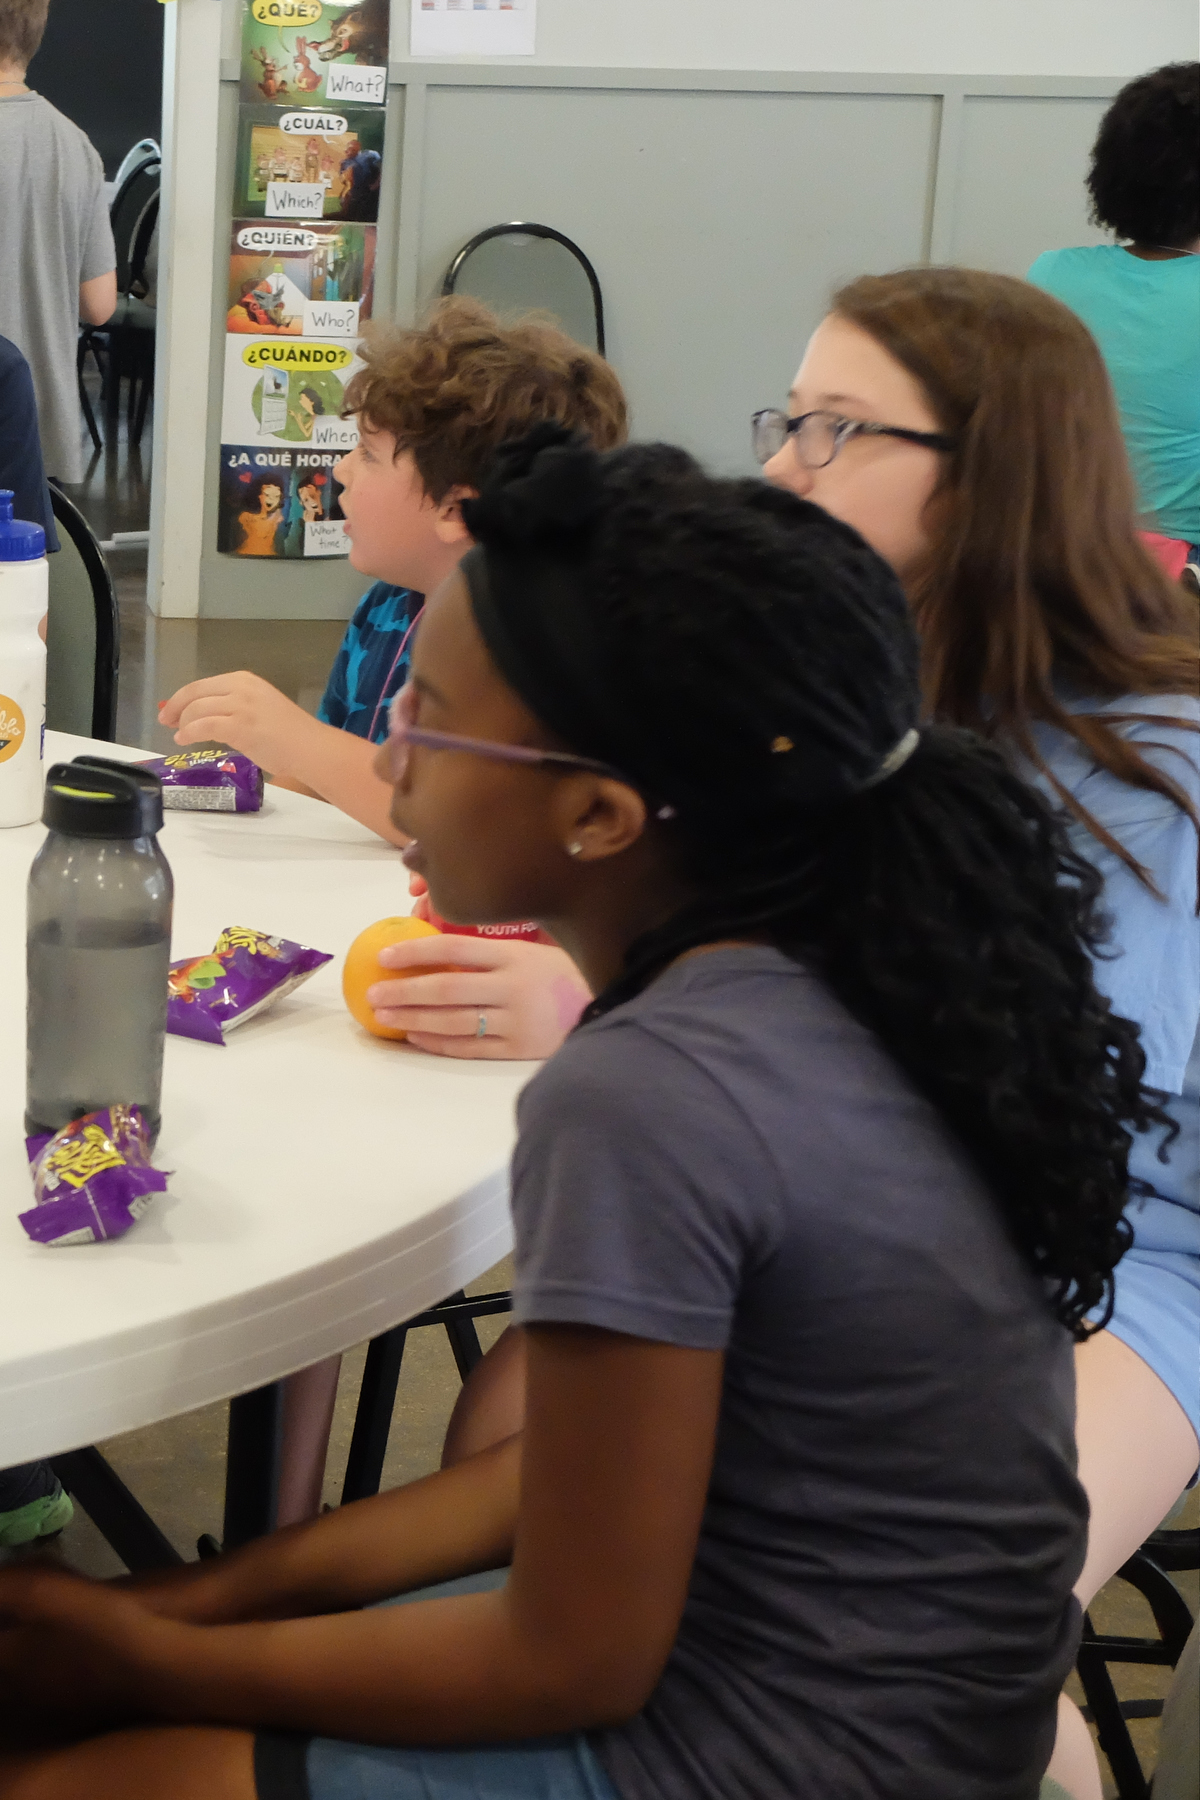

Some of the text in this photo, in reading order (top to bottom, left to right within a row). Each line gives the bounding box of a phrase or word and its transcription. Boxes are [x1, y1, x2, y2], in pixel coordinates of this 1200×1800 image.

[257, 1, 319, 19] ¿QUÉ?
[330, 74, 385, 98] What?
[284, 116, 344, 131] ¿CUÁL?
[272, 189, 322, 211] Which?
[311, 309, 355, 332] Who?
[246, 345, 347, 364] ¿CUÁNDO?
[315, 427, 358, 443] When
[228, 451, 342, 468] ¿A QUÉ HORA
[310, 522, 337, 537] What
[476, 924, 520, 936] YOUTH
